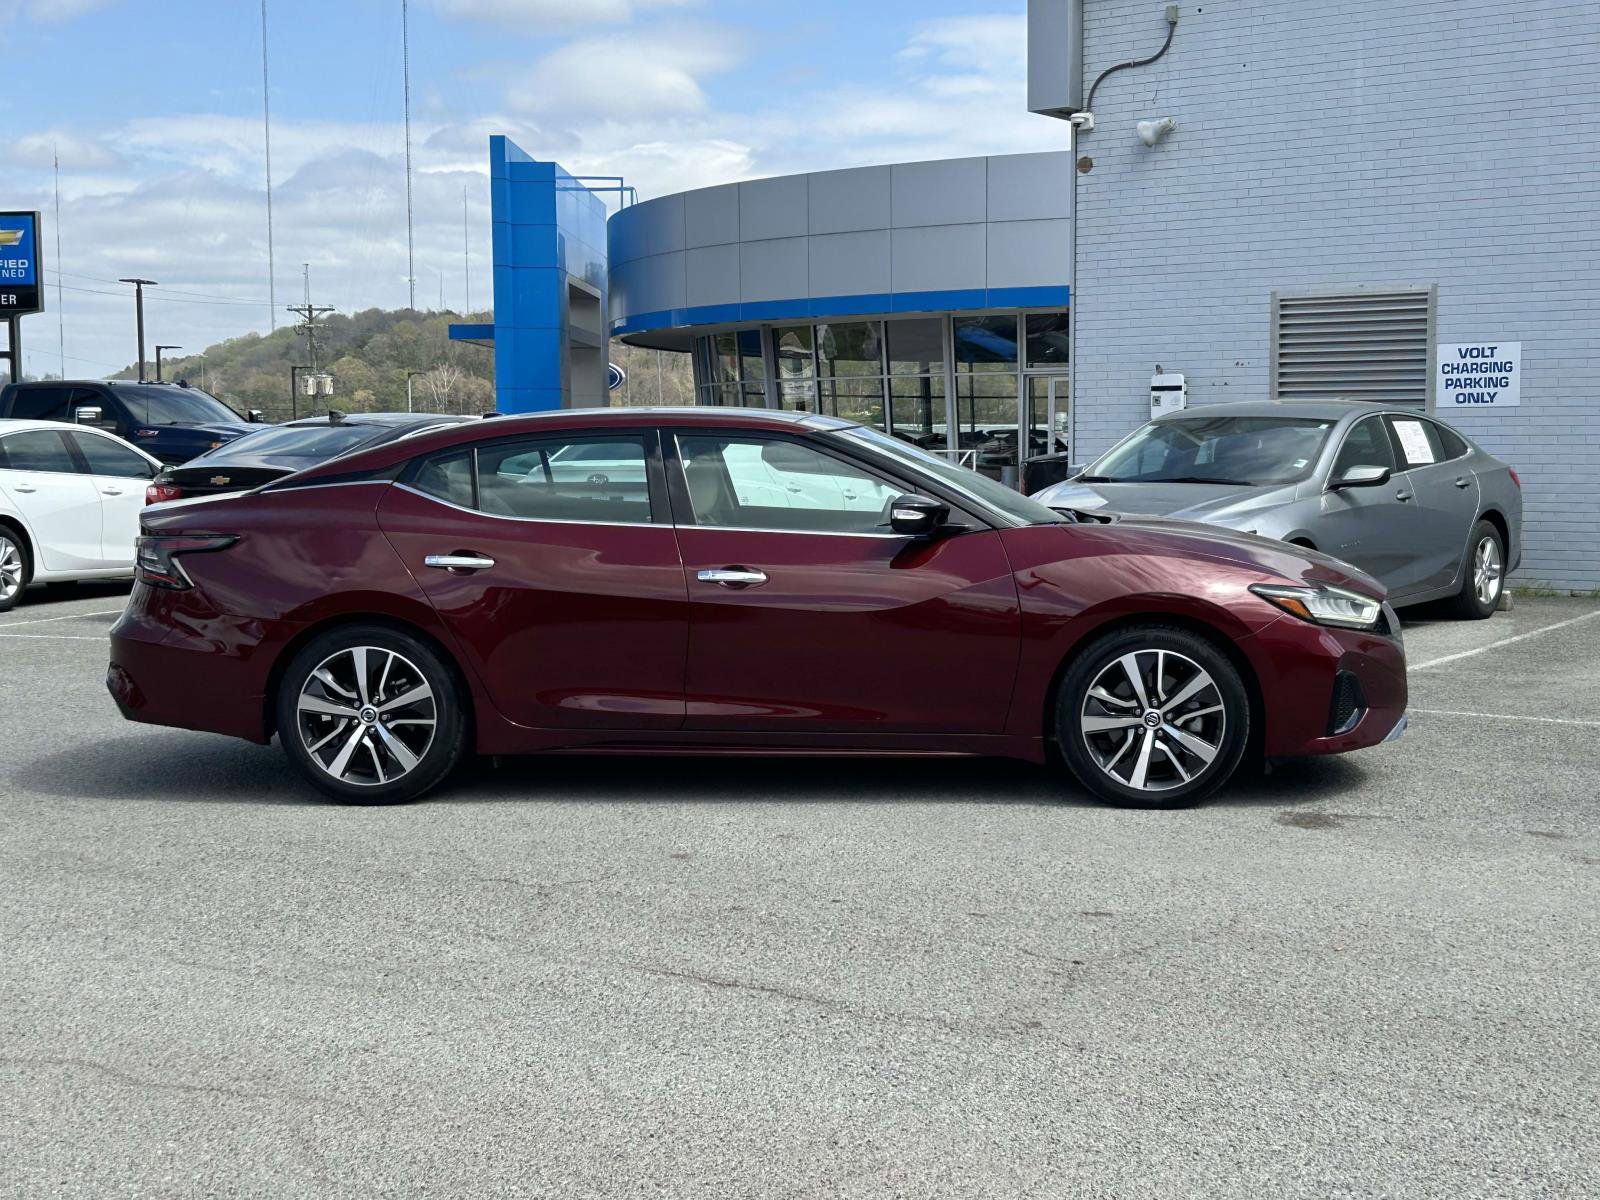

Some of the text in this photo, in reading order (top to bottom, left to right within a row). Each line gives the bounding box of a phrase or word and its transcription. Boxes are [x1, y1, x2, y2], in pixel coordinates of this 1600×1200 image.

[1, 295, 16, 304] ER
[1458, 346, 1497, 359] VOLT
[1442, 361, 1513, 374] CHARGING
[1445, 376, 1509, 389] PARKING
[1455, 392, 1498, 404] ONLY
